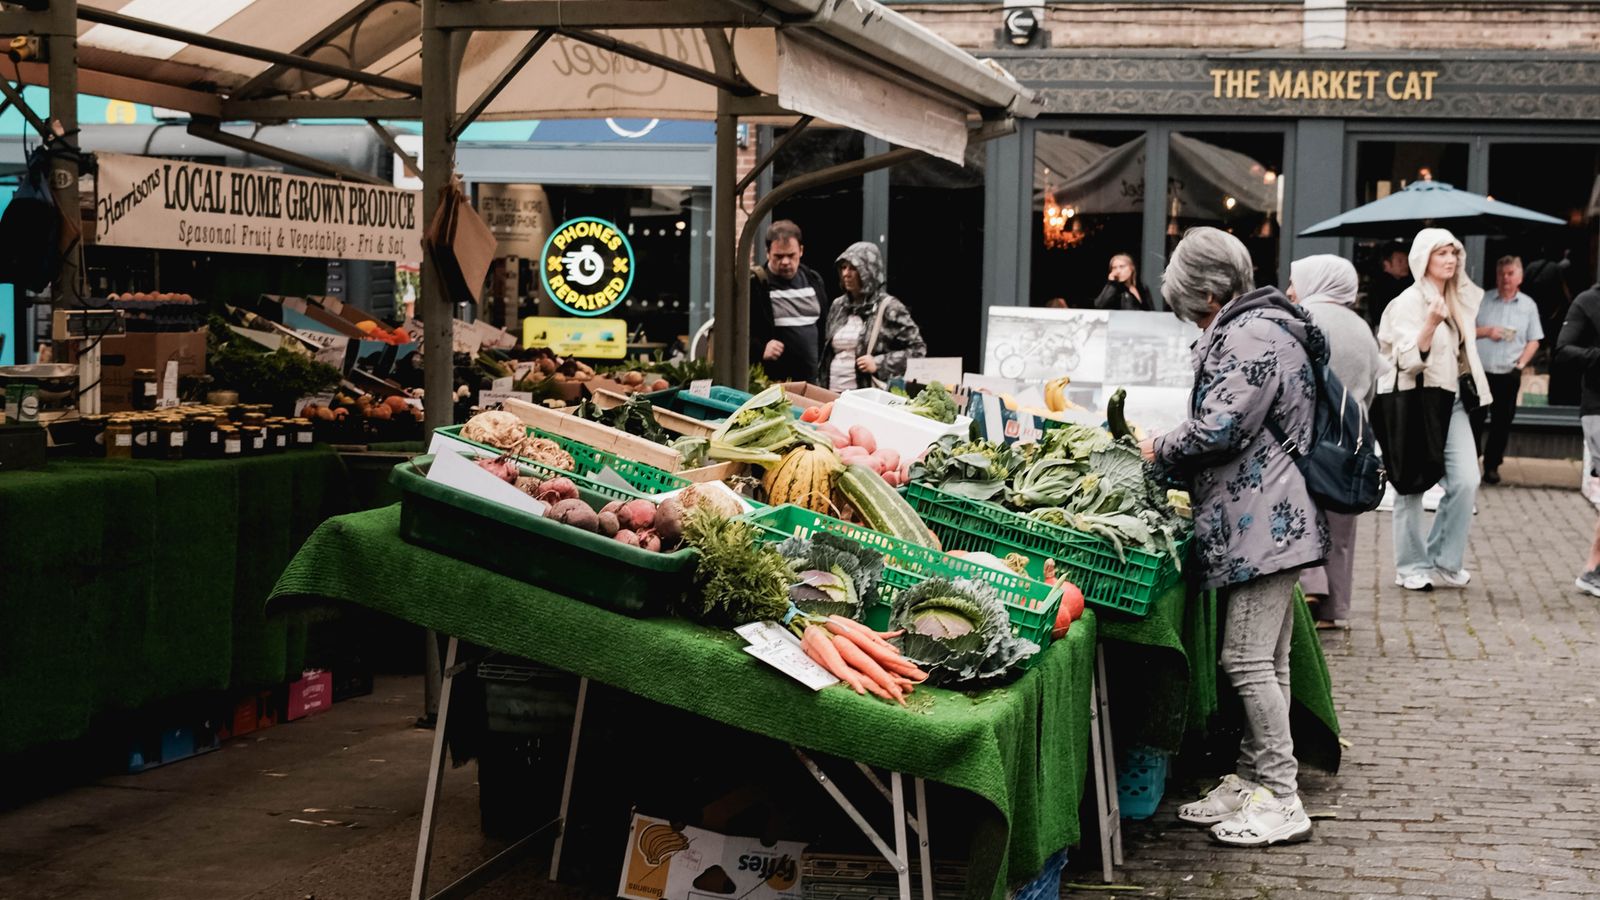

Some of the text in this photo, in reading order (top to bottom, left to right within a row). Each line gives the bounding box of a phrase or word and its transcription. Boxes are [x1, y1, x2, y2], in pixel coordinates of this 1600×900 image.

[1210, 69, 1438, 100] THE MARKET CAT
[98, 168, 161, 235] Harrisons
[163, 165, 415, 230] LOCAL HOME GROWN PRODUCE
[179, 220, 236, 246] Seasonal
[242, 225, 272, 251] Fruit
[277, 228, 285, 248] &
[290, 229, 347, 254] Vegetables
[358, 234, 373, 253] Fri
[377, 237, 384, 254] &
[553, 222, 622, 251] PHONES
[549, 275, 625, 310] REPAIRED
[628, 882, 663, 897] Bananas
